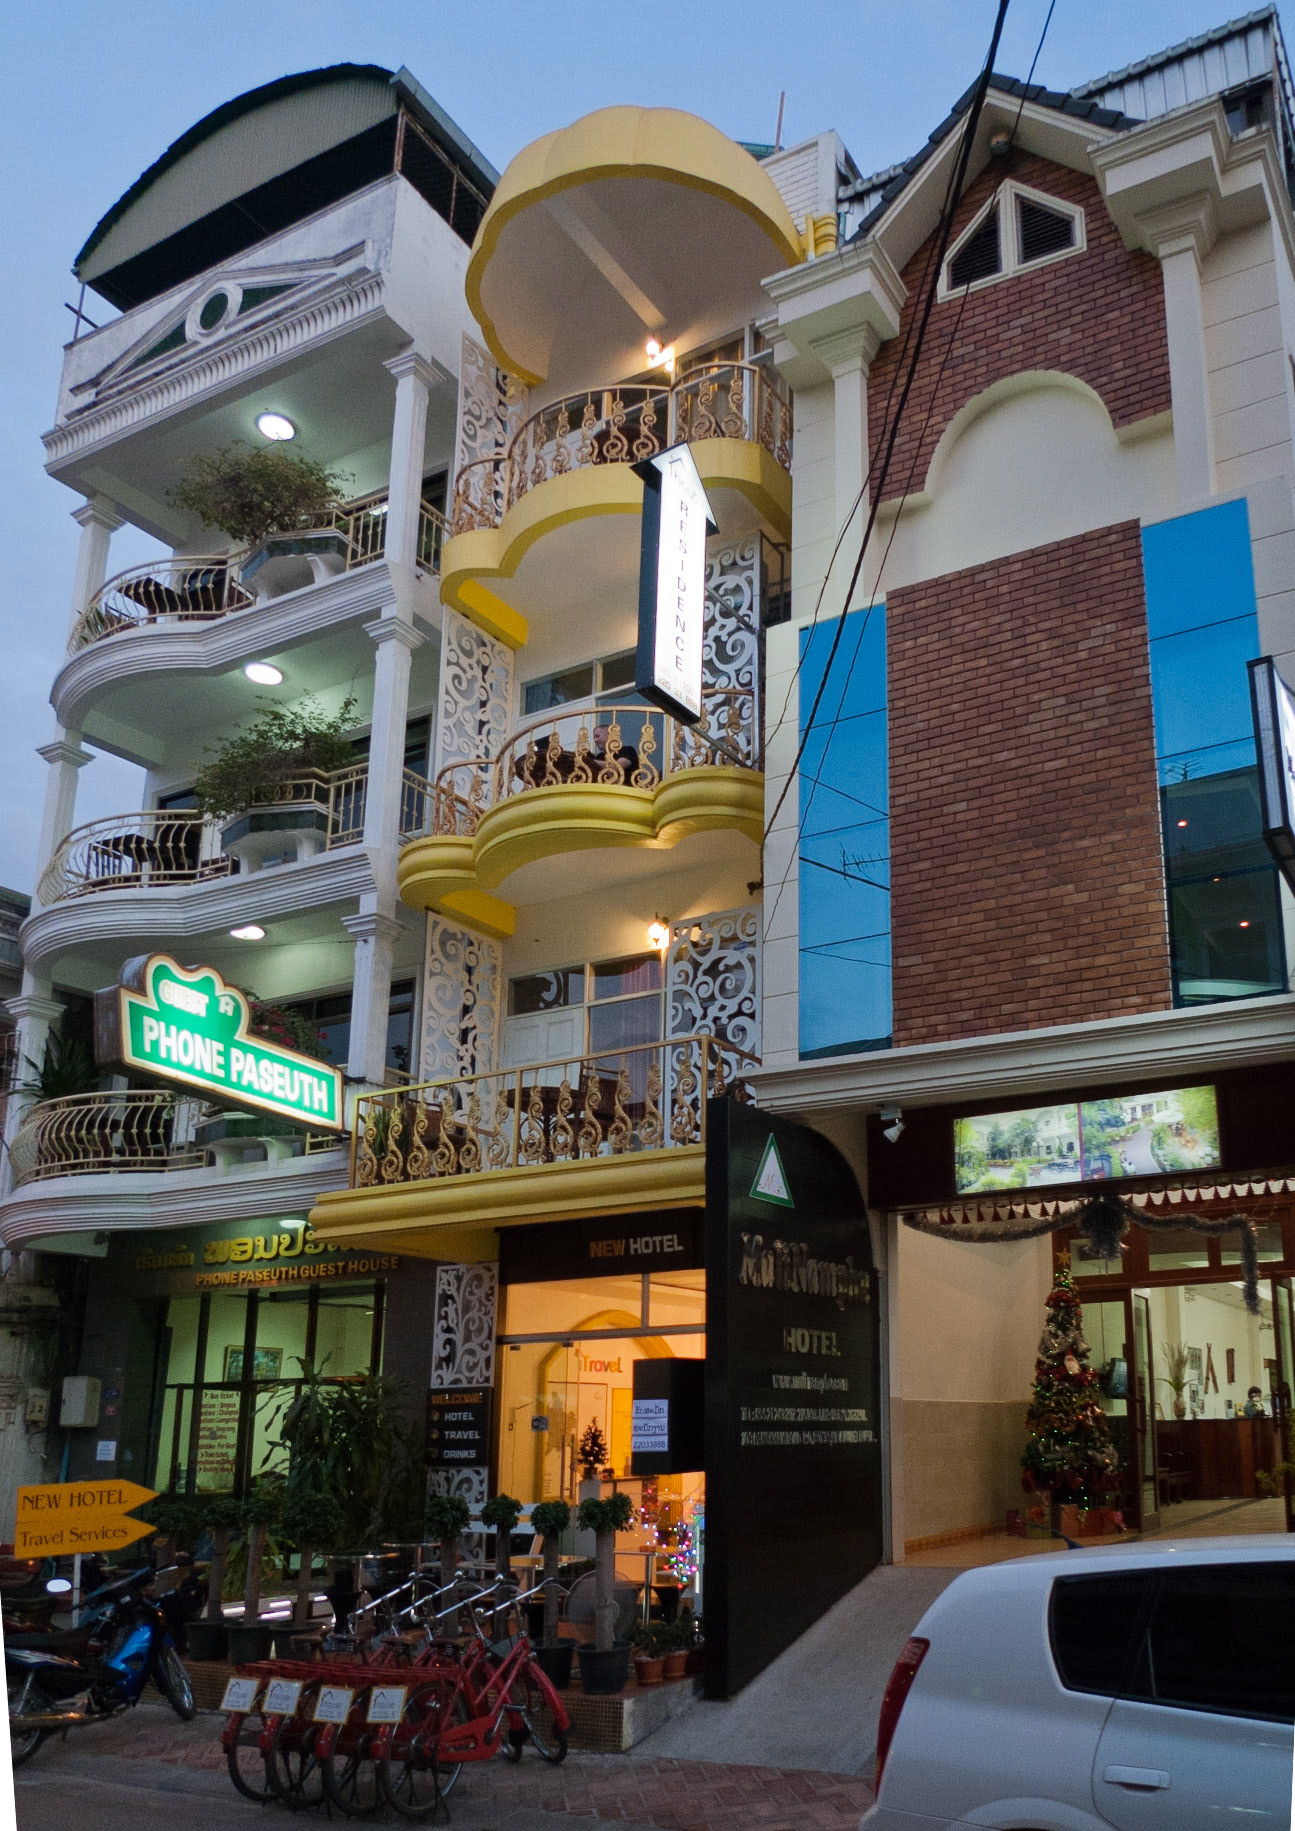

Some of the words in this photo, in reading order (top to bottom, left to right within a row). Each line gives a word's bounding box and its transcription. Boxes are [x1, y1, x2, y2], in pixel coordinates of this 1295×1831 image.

[674, 500, 690, 673] RESIDENCE
[158, 978, 210, 1018] GUEST
[143, 1015, 226, 1077] PHONE
[230, 1047, 328, 1112] PASEUTH
[589, 1238, 625, 1258] NEW
[629, 1234, 684, 1255] HOTEL
[195, 1269, 239, 1287] PHONE
[239, 1265, 298, 1285] PASEUTH
[300, 1261, 344, 1279] GUEST
[347, 1256, 399, 1272] HOUSE
[783, 1326, 842, 1357] HOTEL
[431, 1392, 483, 1405] WELCOME
[444, 1412, 475, 1421] HOTEL
[444, 1430, 481, 1439] TRAVEL
[443, 1449, 477, 1459] DRINKS
[21, 1494, 62, 1511] NEW
[69, 1488, 128, 1507] HOTEL
[20, 1529, 64, 1547] Travel
[69, 1525, 128, 1543] Services
